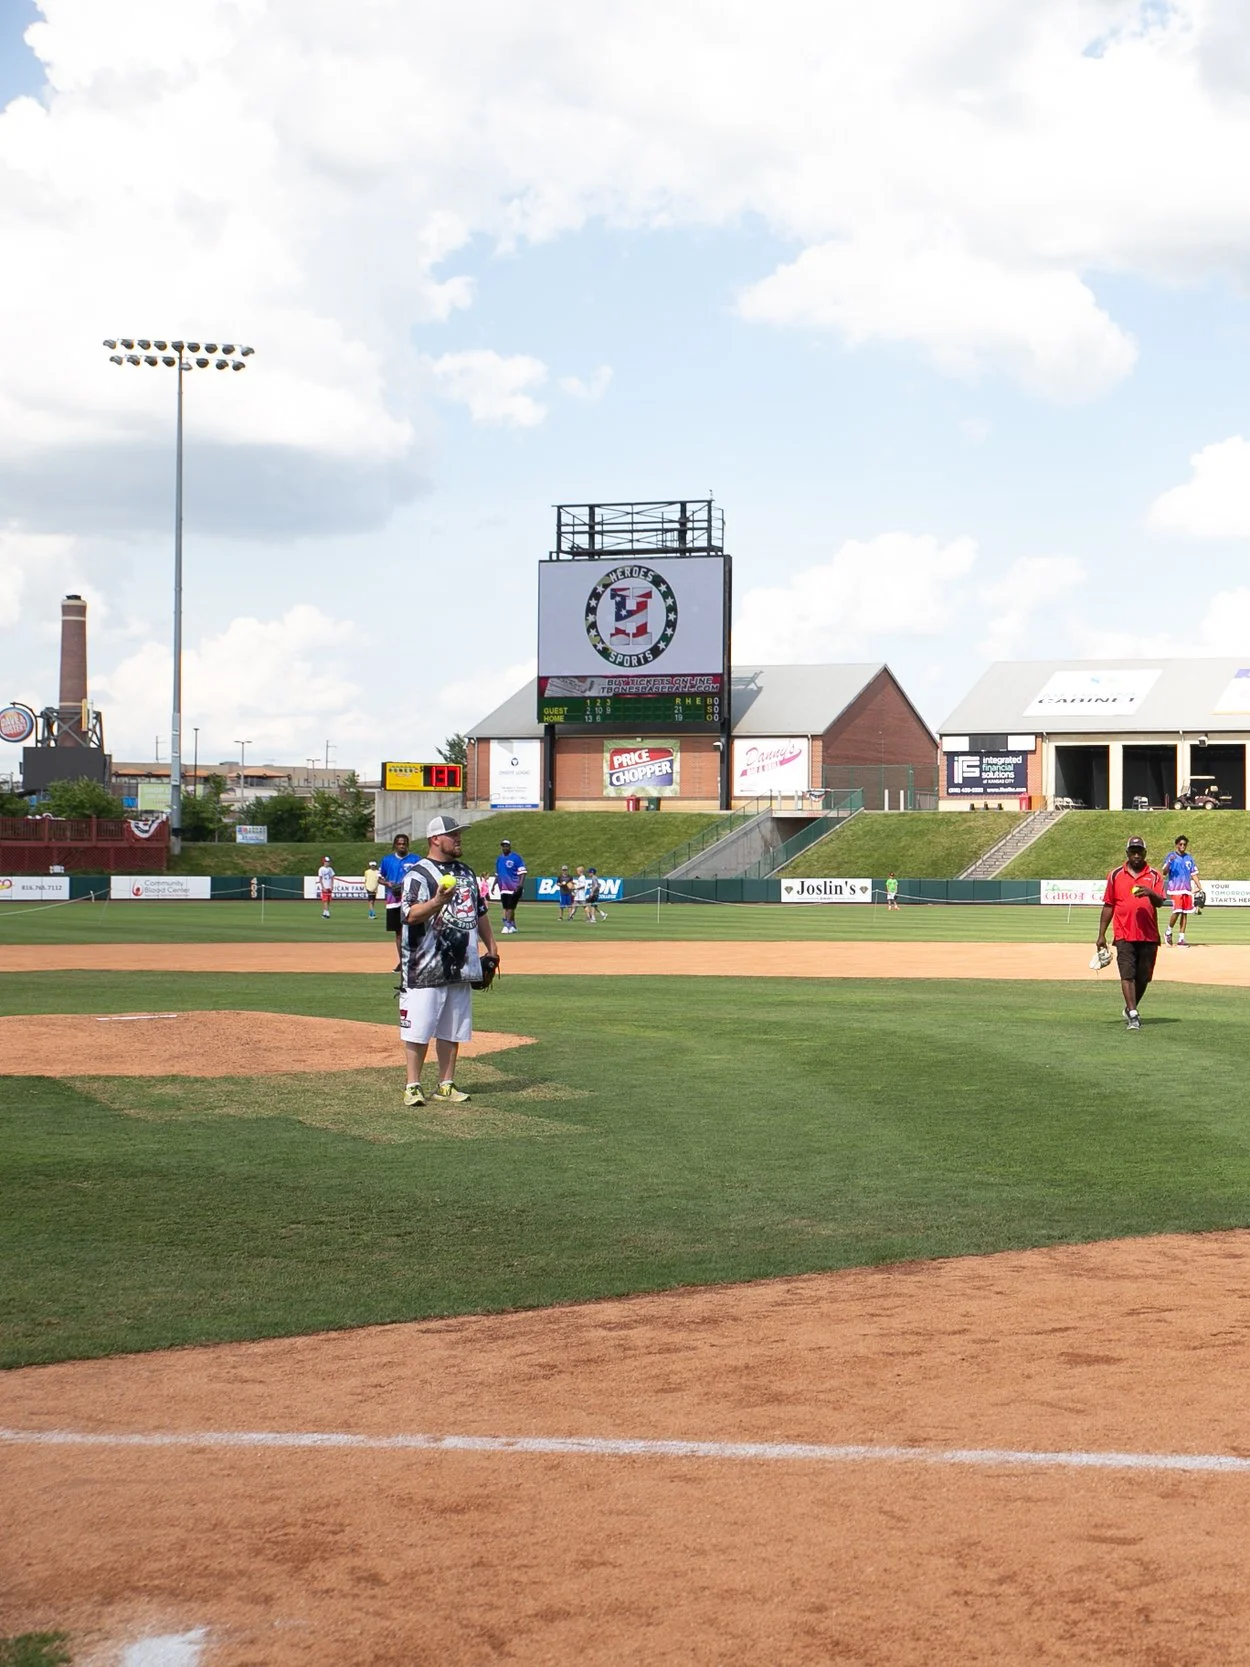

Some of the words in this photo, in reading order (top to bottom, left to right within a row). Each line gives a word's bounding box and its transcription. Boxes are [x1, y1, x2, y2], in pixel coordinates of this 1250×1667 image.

[609, 567, 655, 583] HEROES
[608, 652, 654, 667] SPORTS
[607, 678, 626, 686] BUY
[628, 677, 672, 686] TICKETS
[673, 676, 713, 685] ONLINE
[601, 684, 720, 694] TBONESBASEBALL.COM
[543, 707, 568, 715] GUEST
[613, 749, 650, 768] PRICE
[982, 756, 1023, 764] integrated
[982, 763, 1014, 771] financial
[611, 761, 672, 785] CHOPPER
[981, 771, 1015, 779] solutions
[144, 886, 166, 894] Blood
[166, 886, 190, 894] Center
[796, 880, 857, 896] Joslin's
